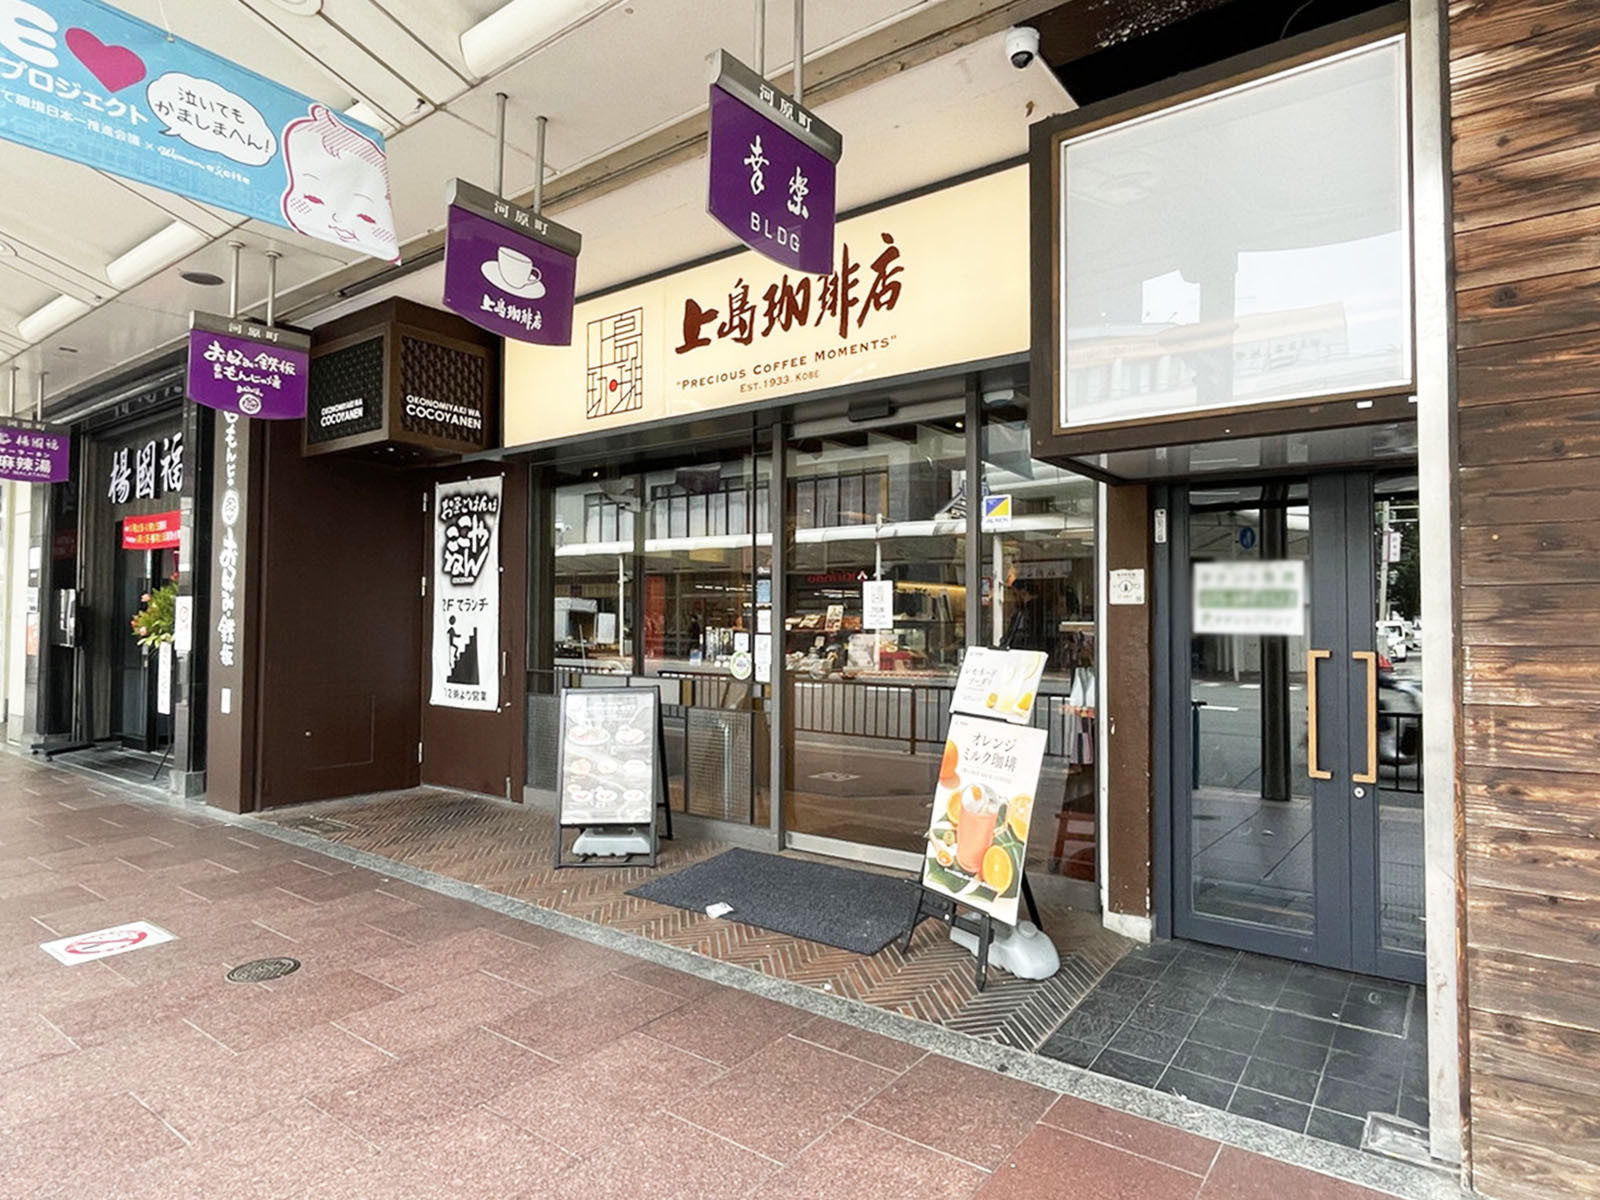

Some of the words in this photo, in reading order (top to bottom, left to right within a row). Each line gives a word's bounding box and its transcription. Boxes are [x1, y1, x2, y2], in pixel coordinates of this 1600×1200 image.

[178, 87, 245, 125] 泣いても
[757, 84, 813, 133] 河原町
[494, 200, 549, 235] 河原町
[750, 211, 800, 252] BLDG
[674, 232, 905, 355] 上島珈琲店
[480, 293, 543, 331] 上島珈琲店
[320, 406, 364, 428] COCOYANEN
[405, 394, 467, 415] OKONOMIYAKI
[467, 407, 481, 418] WA
[405, 403, 482, 430] COCOYANEN
[973, 732, 1017, 752] オレンジ
